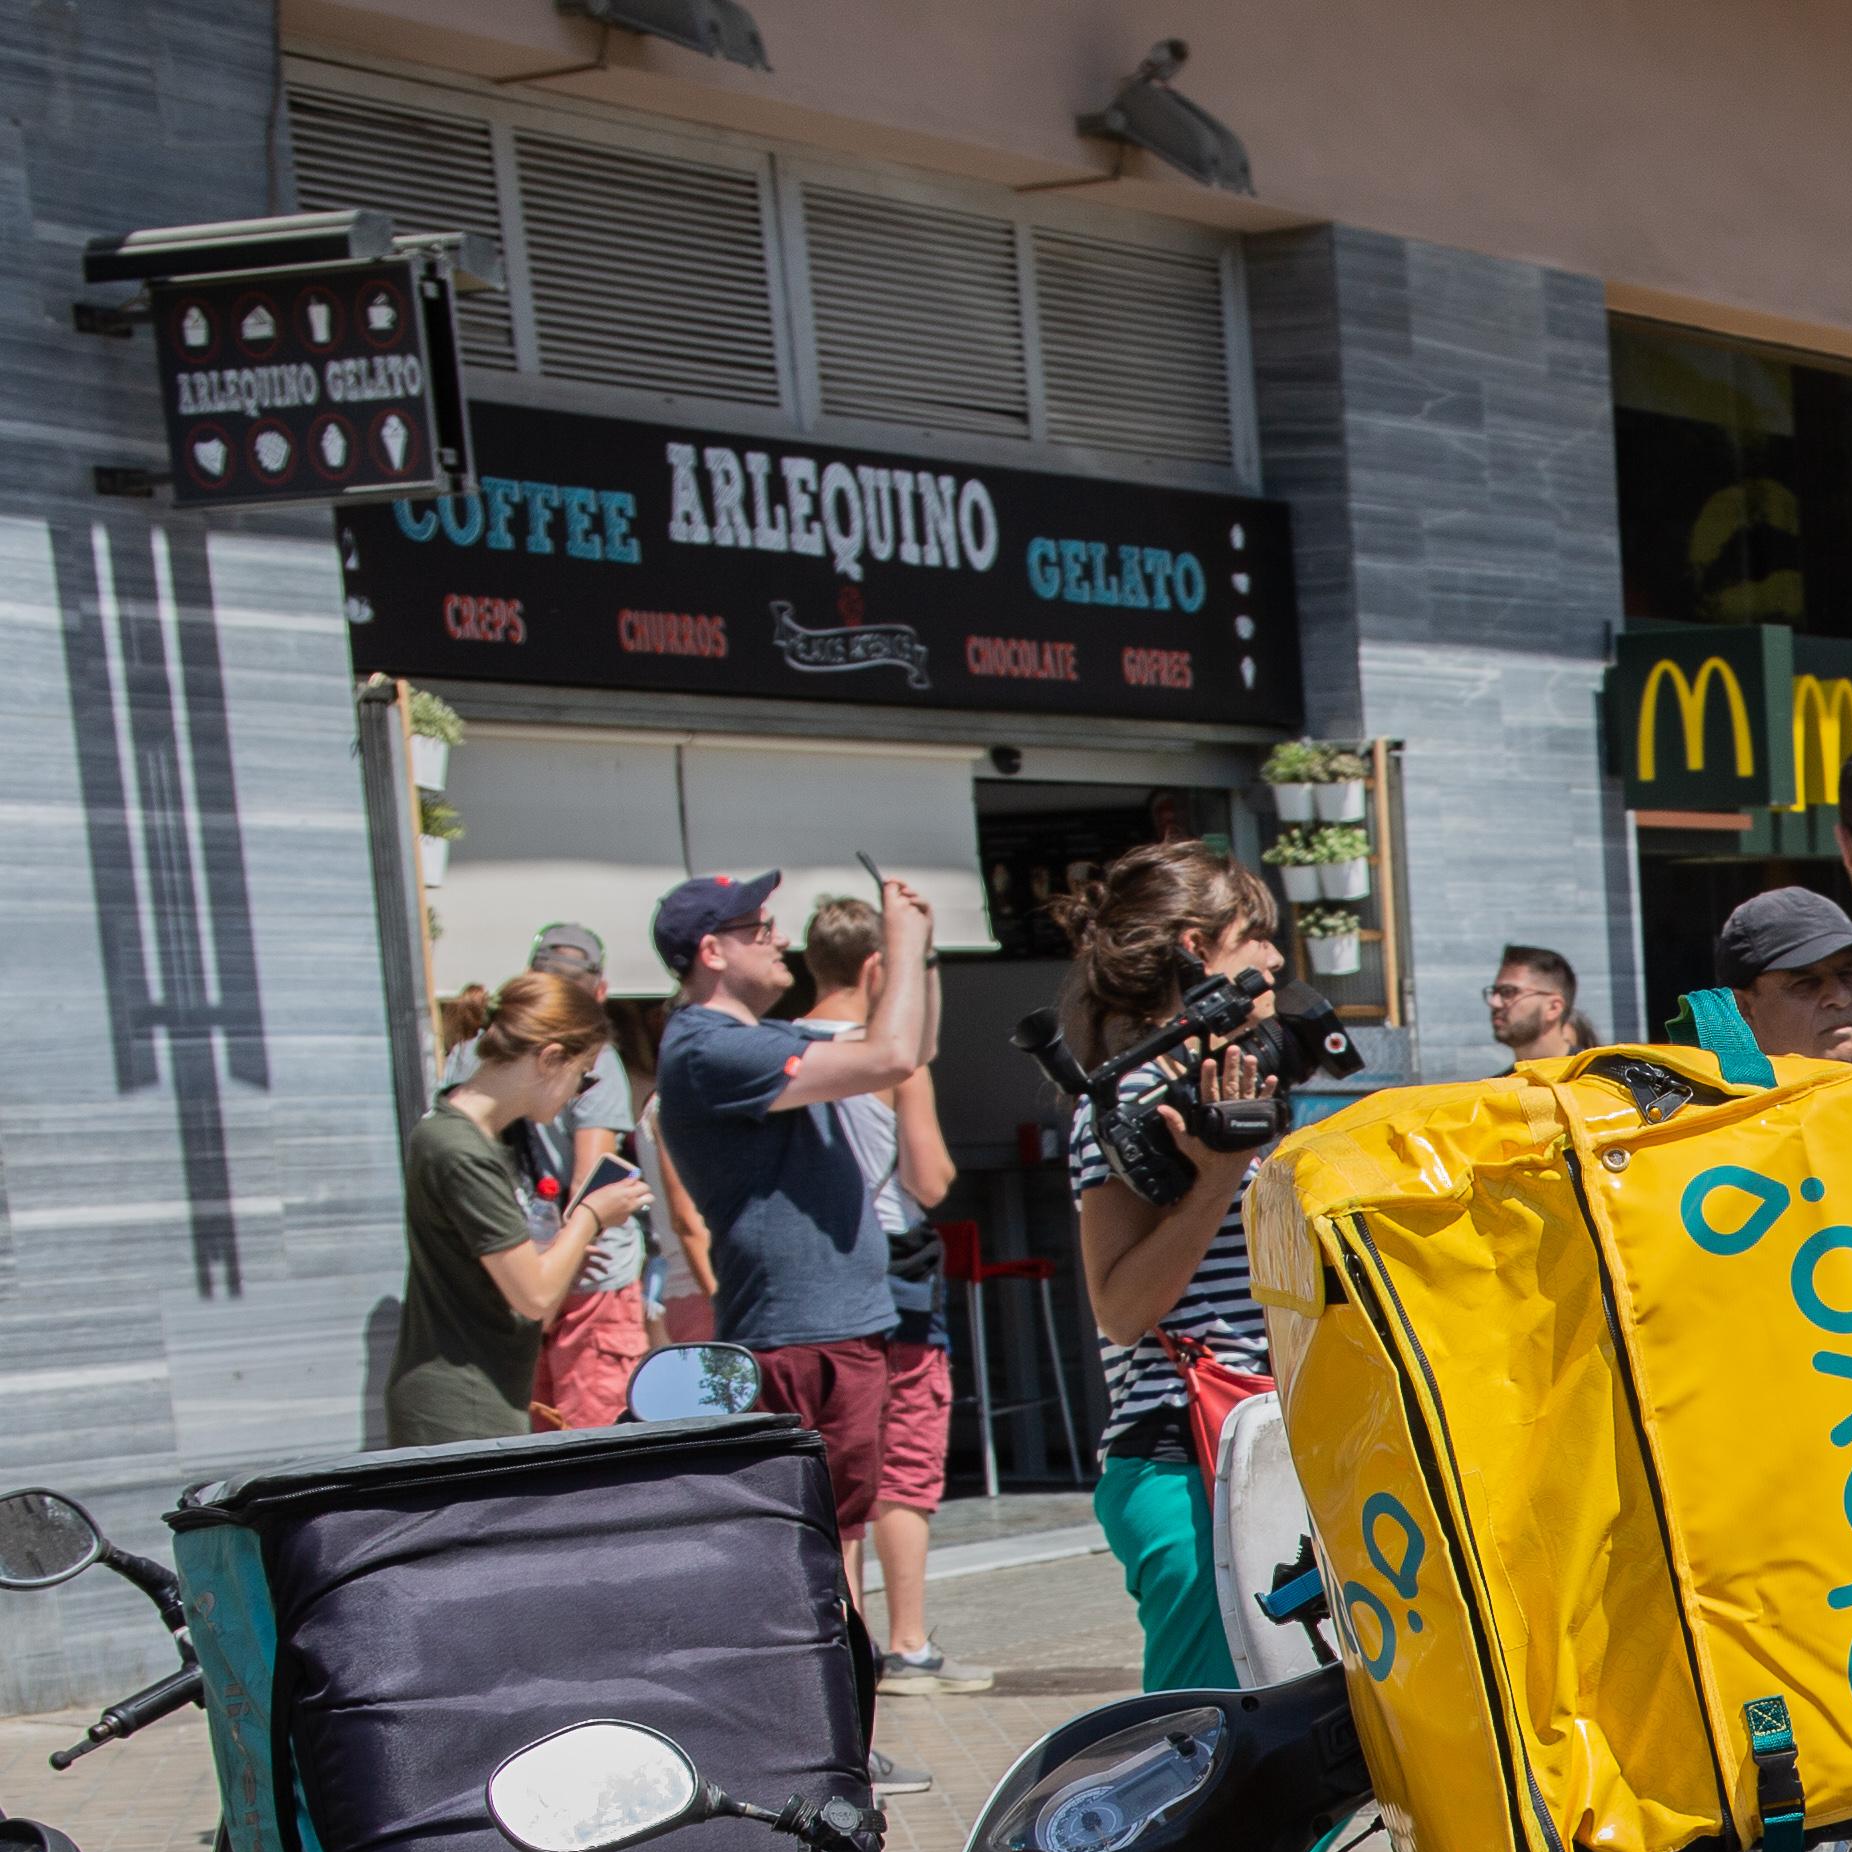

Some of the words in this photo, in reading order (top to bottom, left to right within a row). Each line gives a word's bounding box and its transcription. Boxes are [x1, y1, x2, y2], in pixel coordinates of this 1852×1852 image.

[176, 362, 320, 417] ARLEQUINO
[325, 354, 423, 402] GELATO
[665, 441, 998, 582] ARLEQUINO
[1026, 537, 1206, 613] GELATO
[443, 593, 526, 646] CREPS
[618, 607, 728, 659] CHURROS
[965, 634, 1078, 682] CHOCOLATE
[1121, 647, 1193, 690] GOFRES
